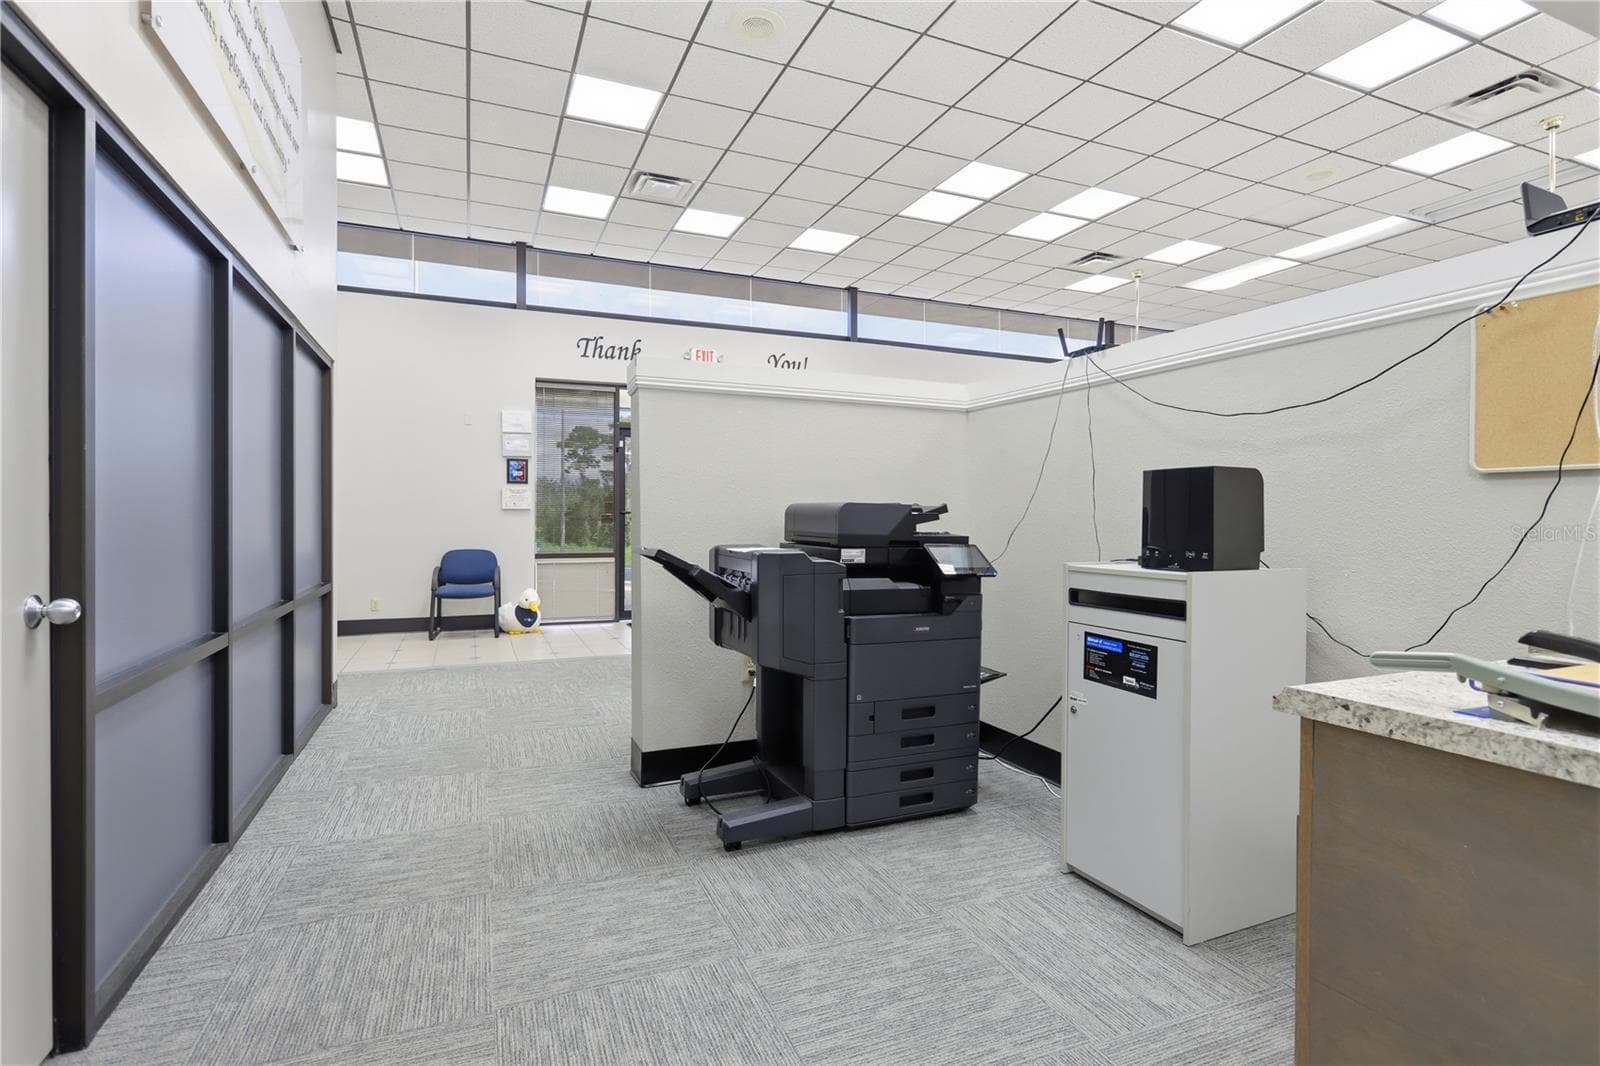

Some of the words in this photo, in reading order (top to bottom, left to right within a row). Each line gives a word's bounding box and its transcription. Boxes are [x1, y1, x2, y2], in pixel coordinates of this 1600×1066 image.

[196, 0, 217, 42] ents,
[576, 336, 642, 361] Thank
[695, 349, 715, 362] EXIT
